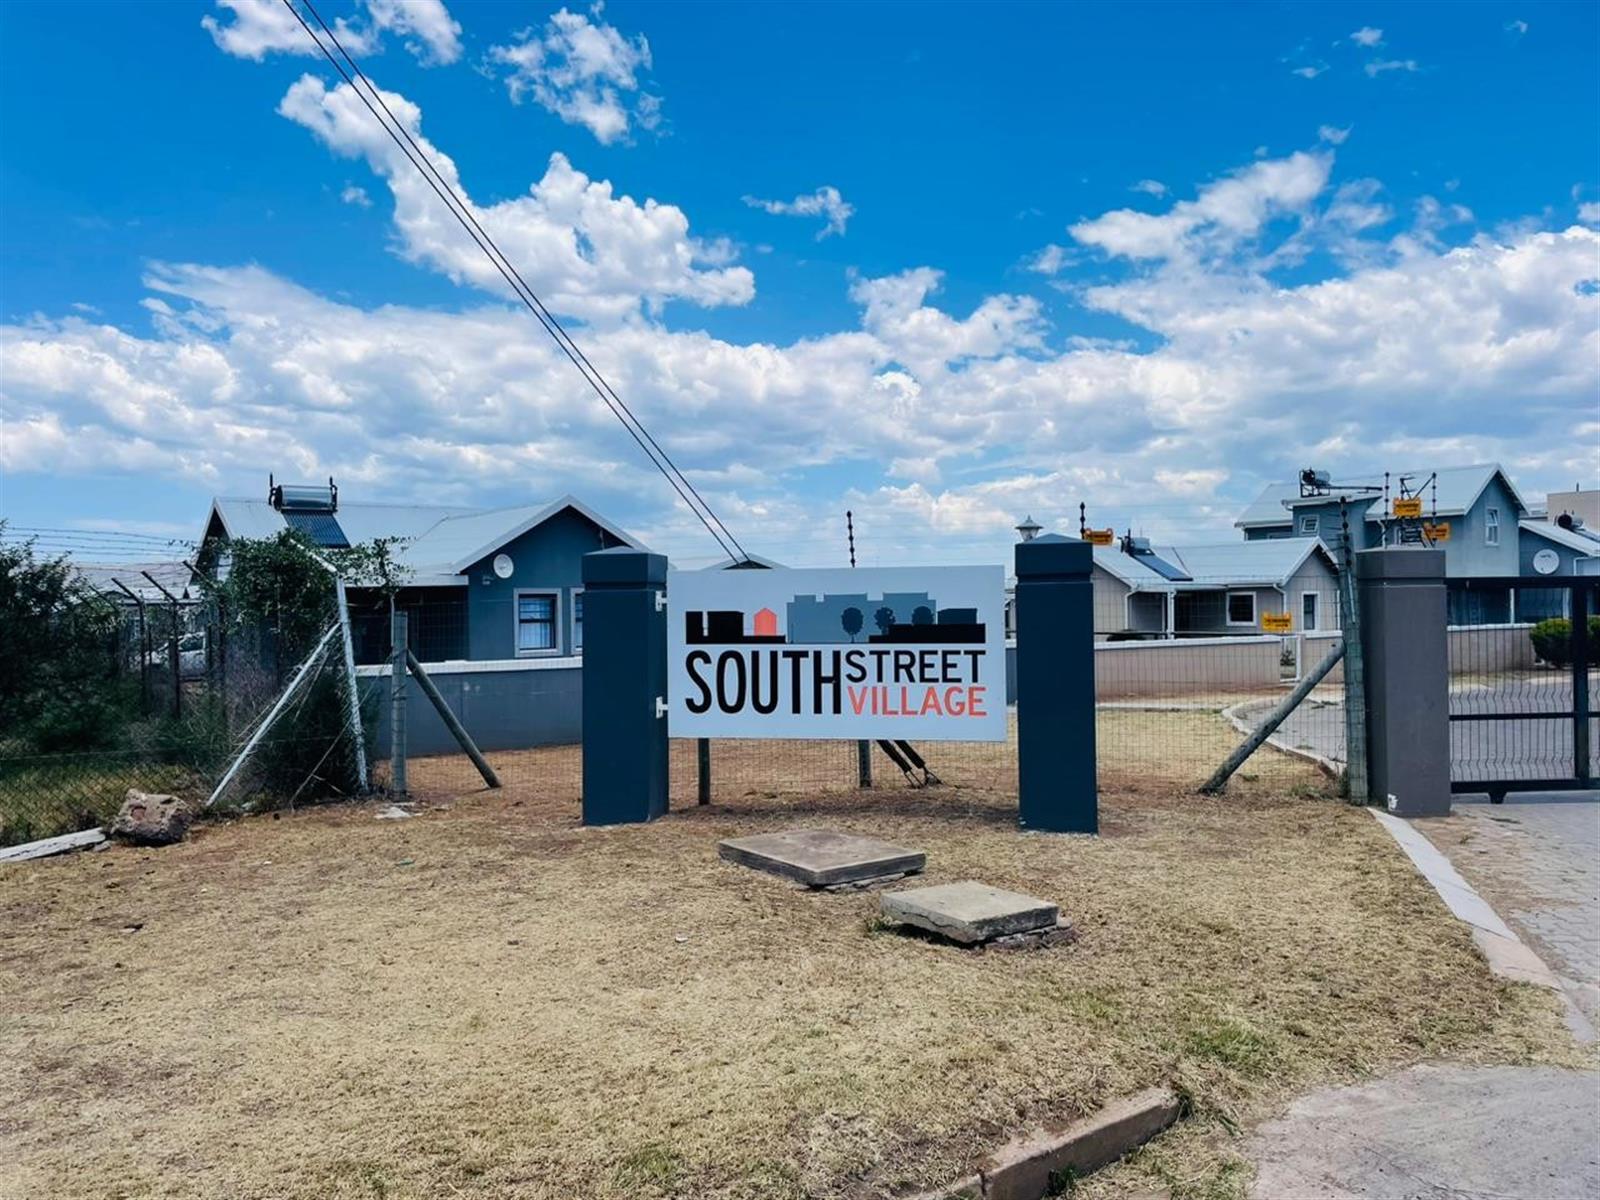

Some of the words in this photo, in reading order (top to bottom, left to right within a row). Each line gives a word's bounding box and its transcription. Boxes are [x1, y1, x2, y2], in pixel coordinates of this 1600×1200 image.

[685, 649, 842, 715] SOUTH
[845, 649, 987, 683] STREET
[847, 686, 988, 717] VILLAGE
